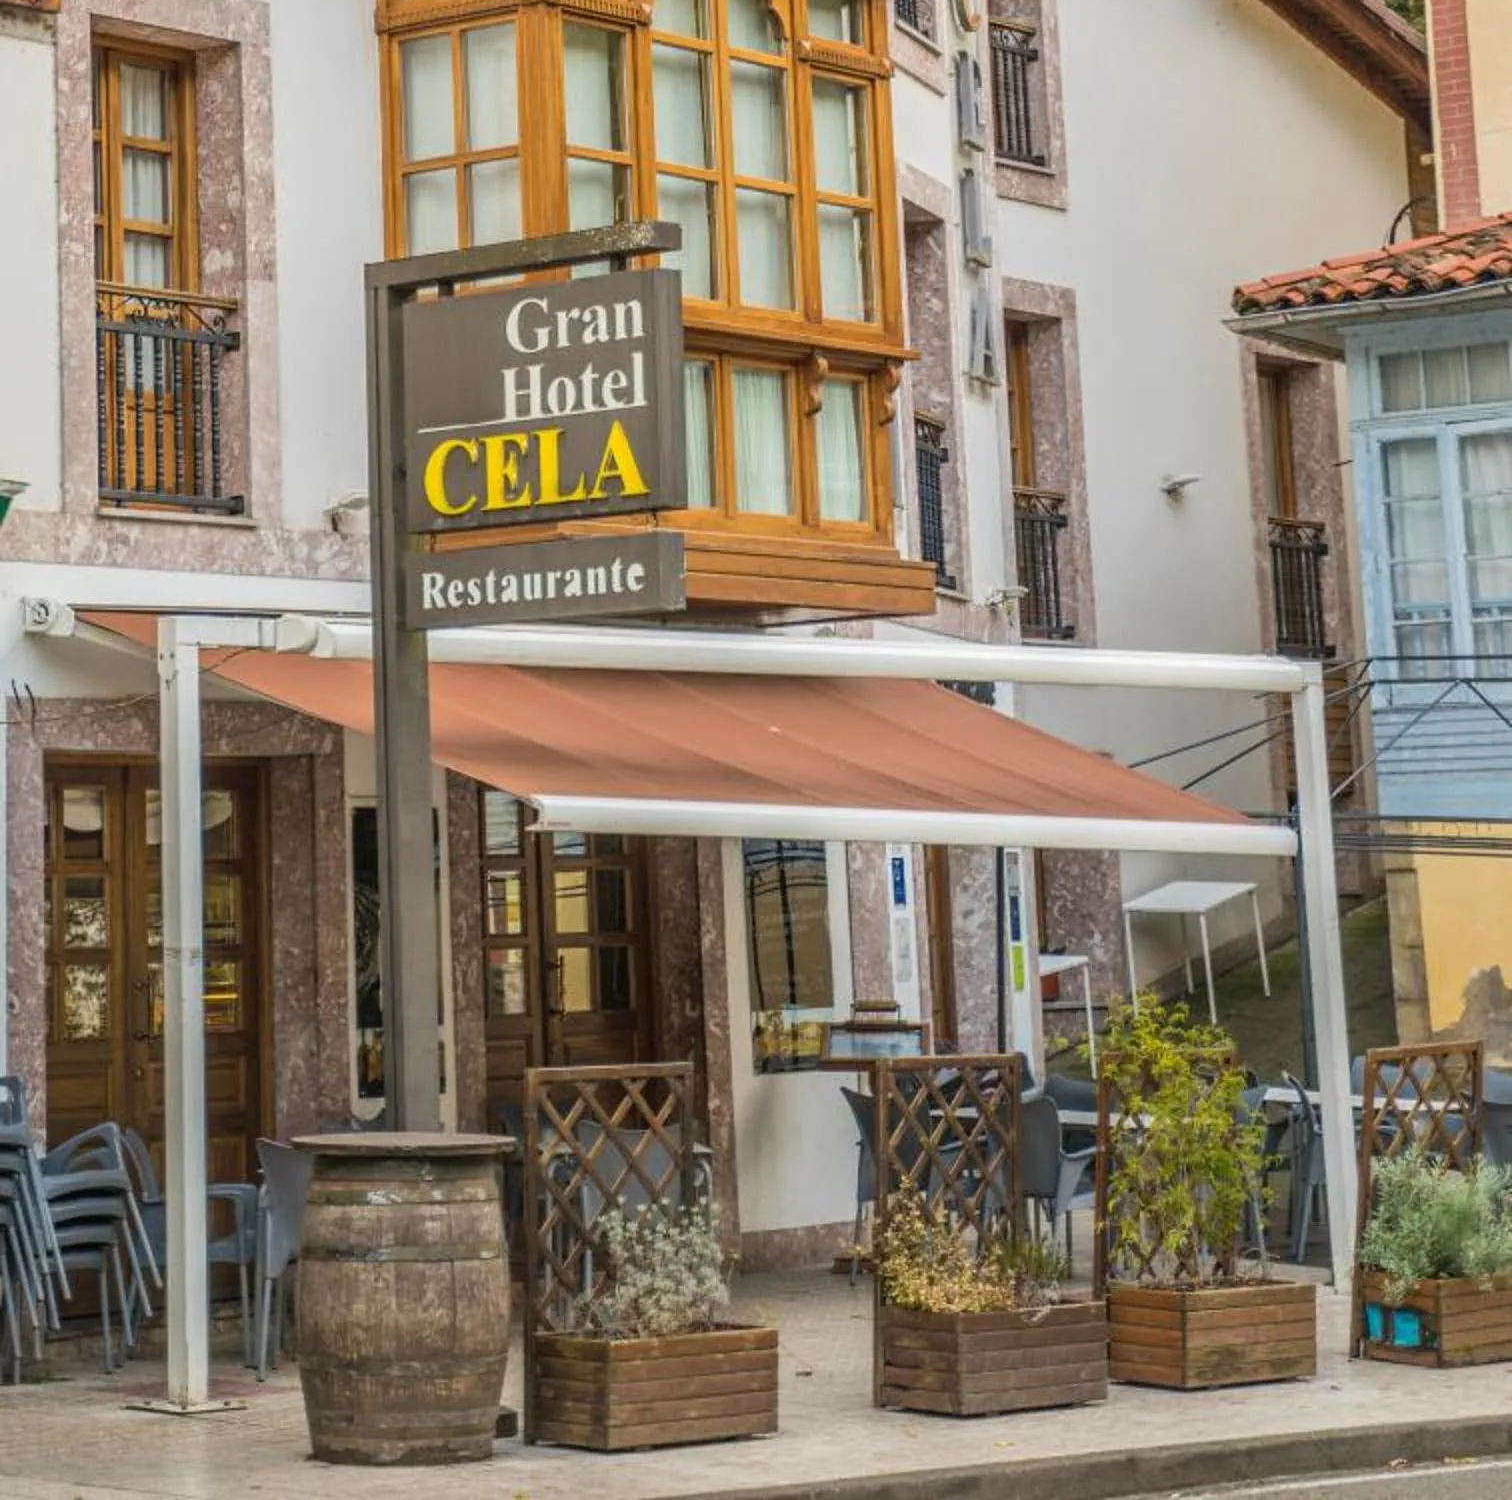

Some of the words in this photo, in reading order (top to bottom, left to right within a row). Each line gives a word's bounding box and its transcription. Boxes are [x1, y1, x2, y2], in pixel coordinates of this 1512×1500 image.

[505, 297, 644, 353] Gran
[501, 352, 648, 423] Hotel
[423, 419, 649, 516] CELA
[421, 556, 645, 610] Restaurante
